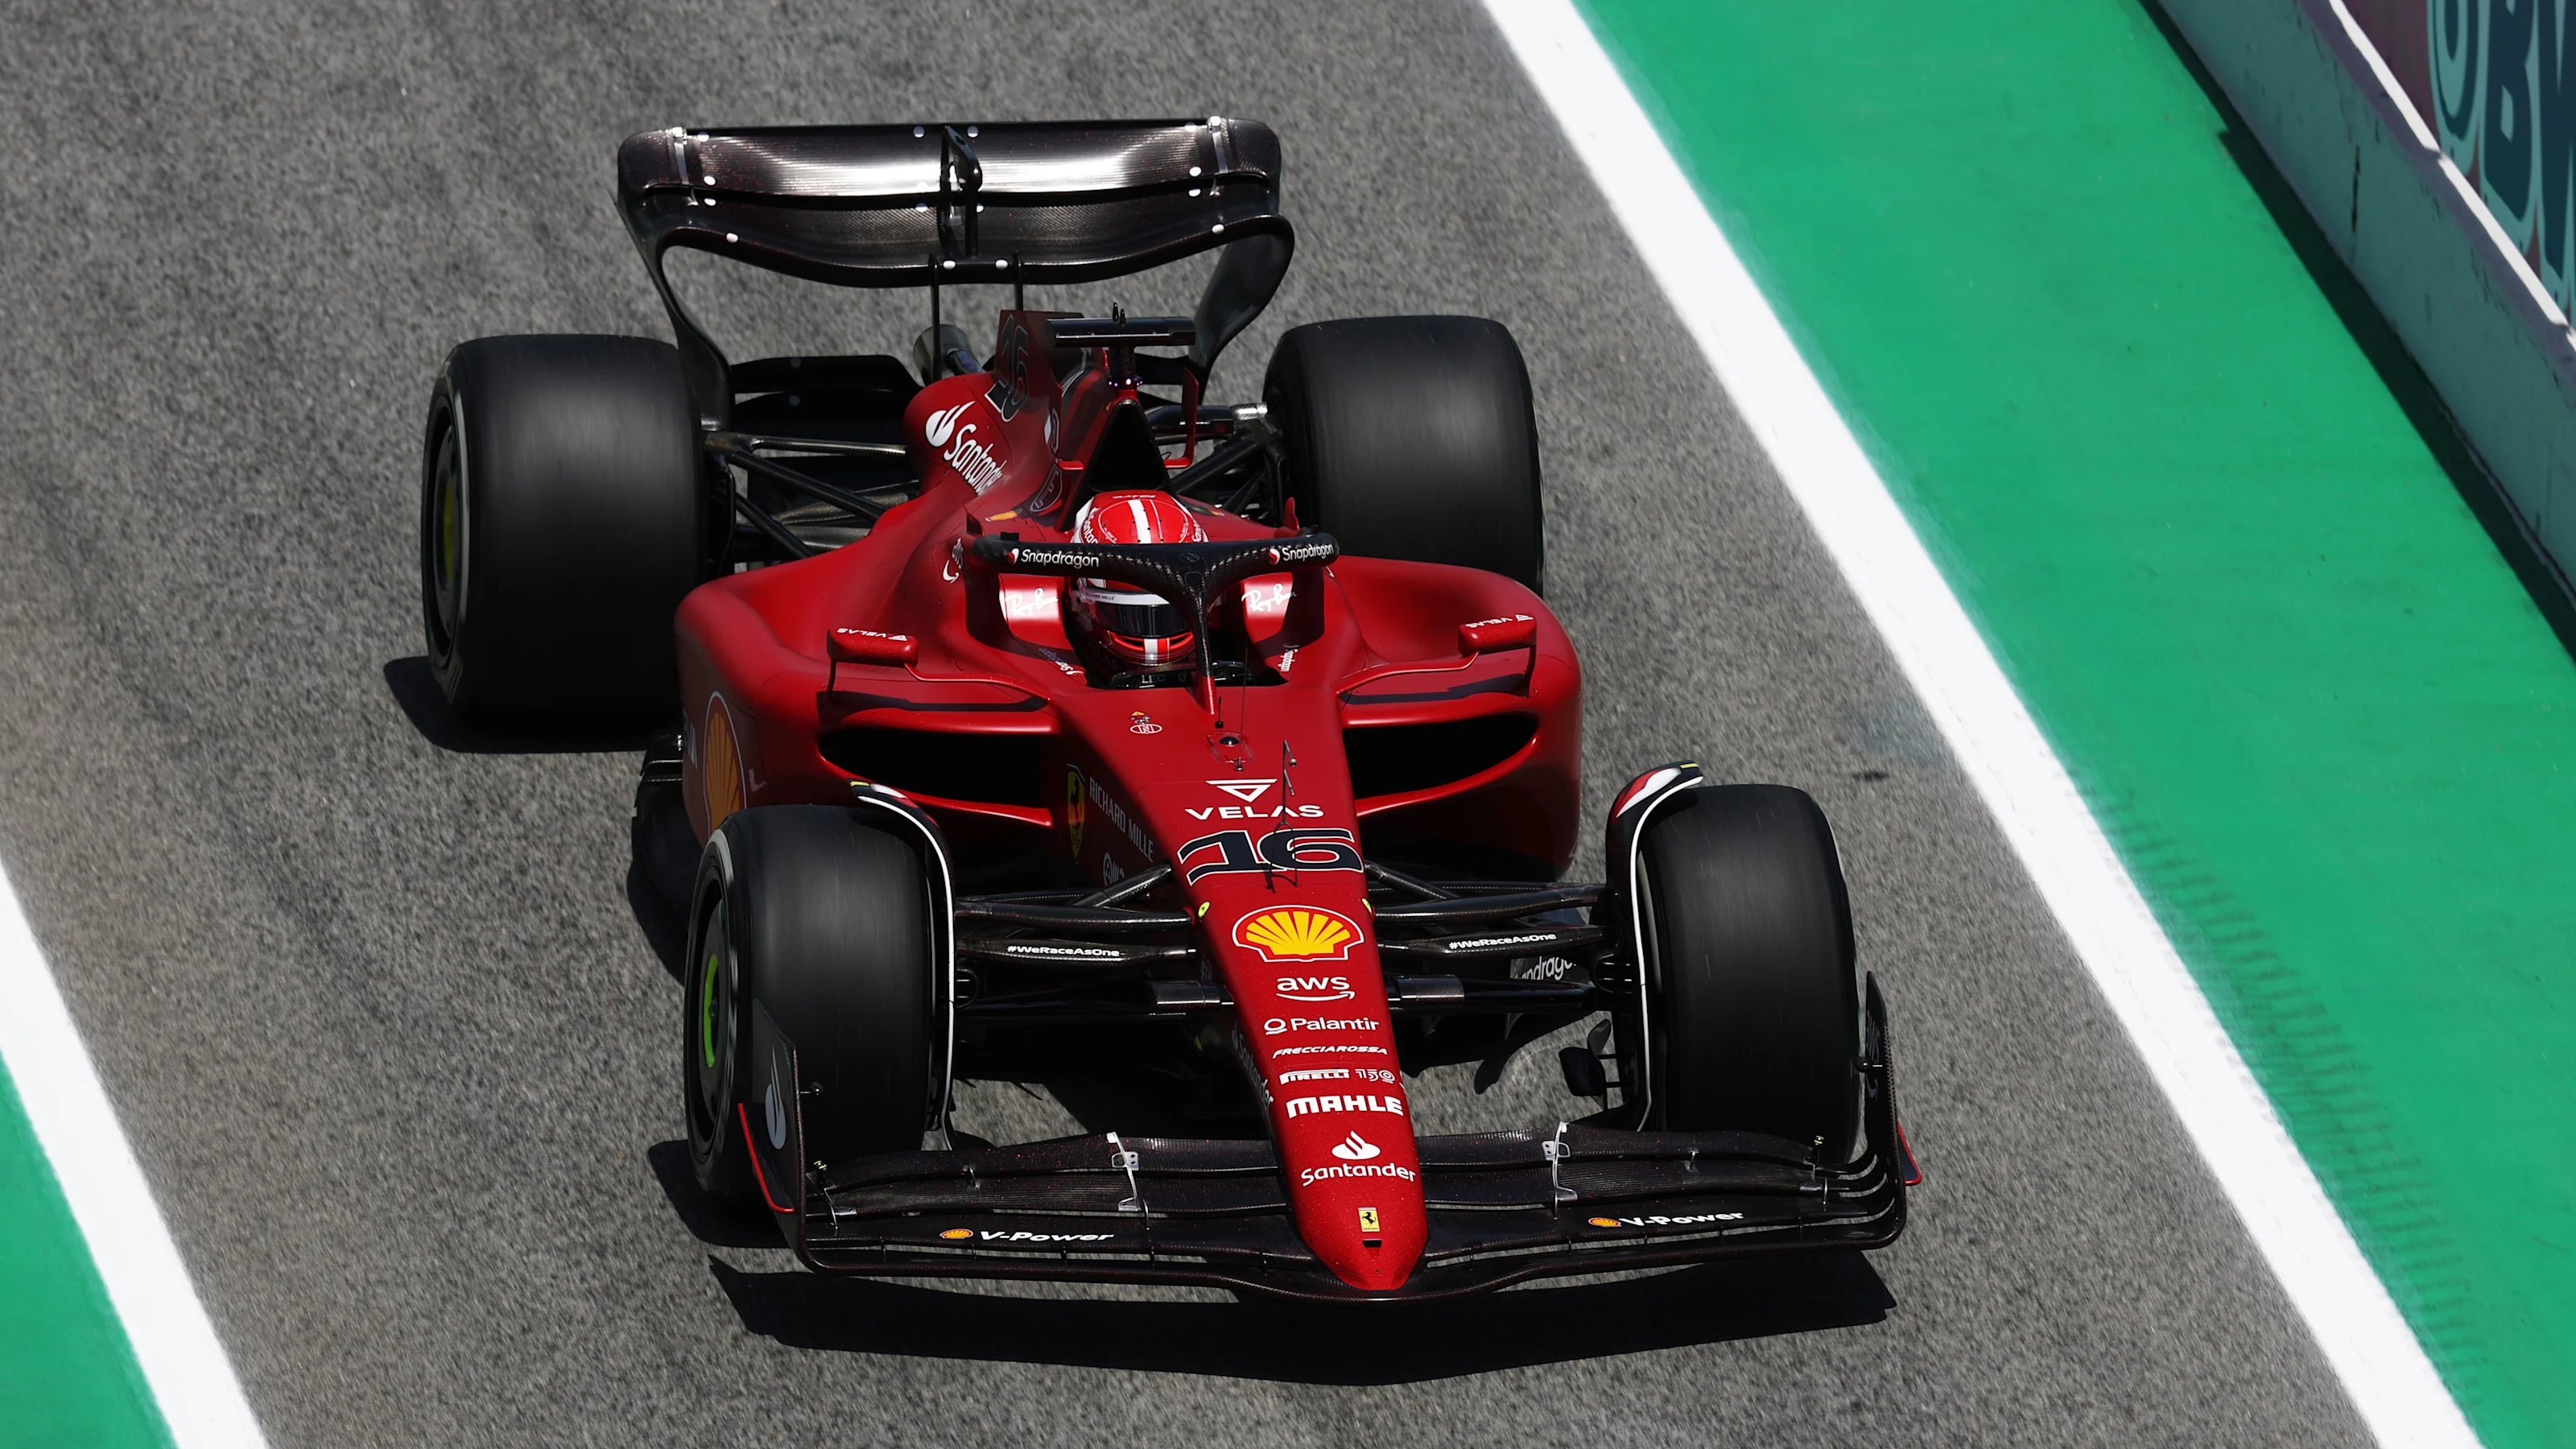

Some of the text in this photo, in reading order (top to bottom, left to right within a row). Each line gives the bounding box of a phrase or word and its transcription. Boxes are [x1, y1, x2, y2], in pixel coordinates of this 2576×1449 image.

[1021, 548, 1100, 569] Snapdragon
[1282, 543, 1335, 563] Snapdragon
[836, 627, 887, 638] VELAS
[1089, 776, 1126, 834] RICHARD
[1128, 818, 1154, 864] MILLE
[1184, 804, 1325, 821] VELAS
[1177, 828, 1364, 887] 16
[1448, 933, 1558, 950] #WeRaceAsOne
[1006, 945, 1121, 957] #WeRaceAsOne
[1277, 976, 1351, 991] aws
[1290, 1017, 1380, 1031] Palantir
[1272, 1046, 1388, 1059] FRECCIAROSSA
[1239, 1033, 1274, 1113] Santander
[1279, 1068, 1350, 1085] PIRELLI
[1286, 1095, 1404, 1119] MAHLE
[1301, 1162, 1416, 1187] Santander
[1618, 1212, 1744, 1227] V-Power
[980, 1230, 1115, 1241] V-Power
